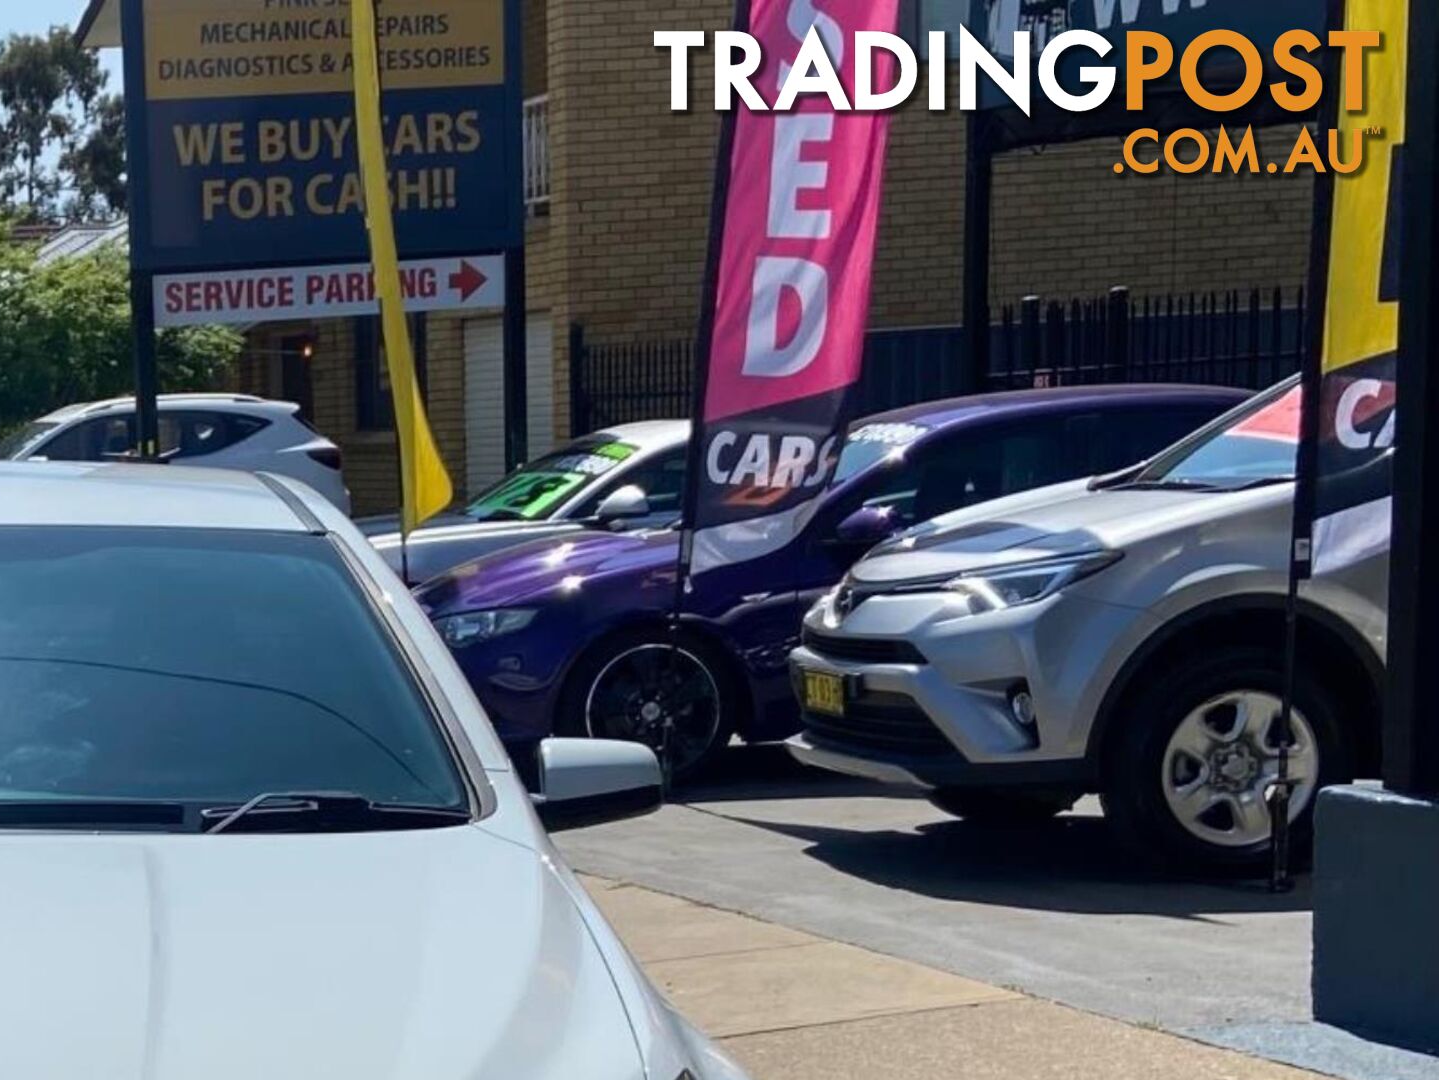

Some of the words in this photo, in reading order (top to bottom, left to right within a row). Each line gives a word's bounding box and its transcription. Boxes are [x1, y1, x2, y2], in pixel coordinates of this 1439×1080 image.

[200, 18, 352, 46] MECHANICAL
[375, 14, 448, 38] EPAIRS
[159, 54, 311, 80] DIAGNOSTICS
[319, 52, 336, 73] &
[341, 46, 491, 73] AESSORIES
[173, 120, 245, 167] WE
[259, 116, 351, 163] BUY
[383, 109, 481, 157] ARS
[201, 176, 294, 221] FOR
[306, 168, 456, 215] CAH!!
[165, 276, 294, 313] SERVICE
[306, 267, 437, 305] PARNG
